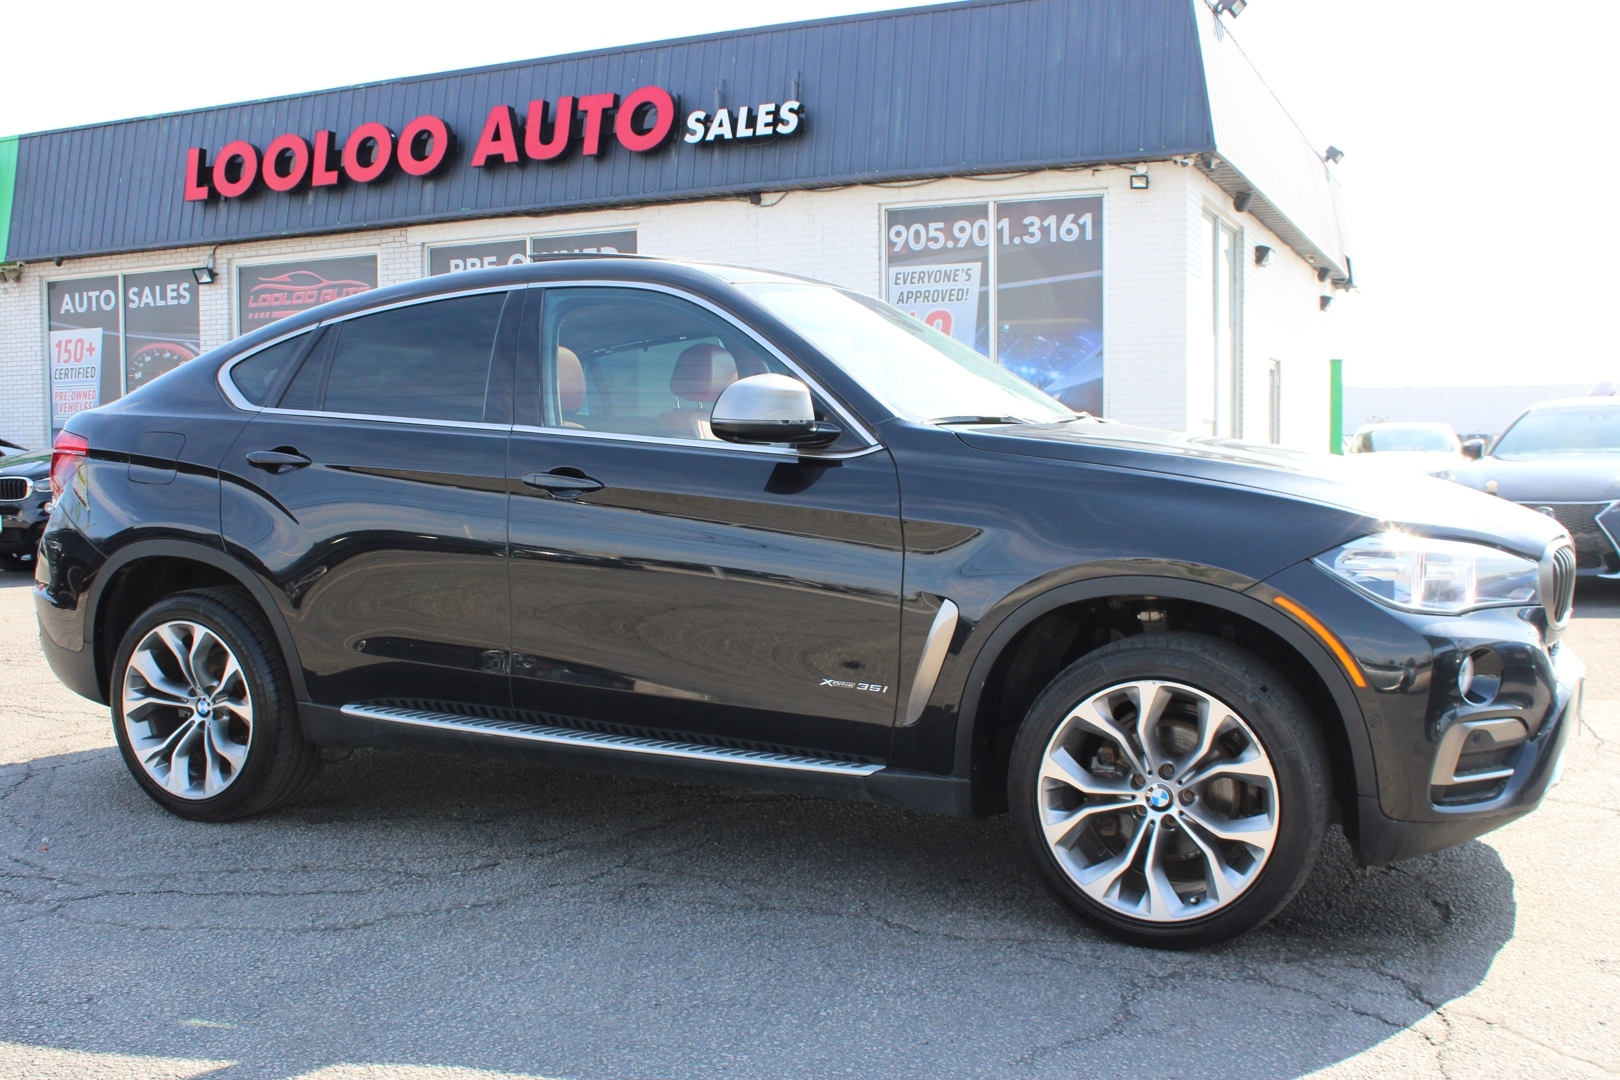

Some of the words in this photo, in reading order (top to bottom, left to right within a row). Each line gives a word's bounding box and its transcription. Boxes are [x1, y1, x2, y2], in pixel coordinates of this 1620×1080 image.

[184, 114, 449, 202] LOOLOO
[470, 85, 676, 168] AUTO
[684, 99, 801, 145] SALES
[888, 212, 1094, 252] 905.901.3161
[893, 267, 973, 286] EVERYONE'S
[60, 289, 116, 315] AUTO
[128, 282, 191, 309] SALES
[247, 290, 319, 308] LOOLOO
[896, 287, 970, 305] APPROVED!
[54, 337, 97, 364] 150+
[54, 366, 97, 381] CERTIFIED
[54, 389, 97, 401] PRE-OWNED
